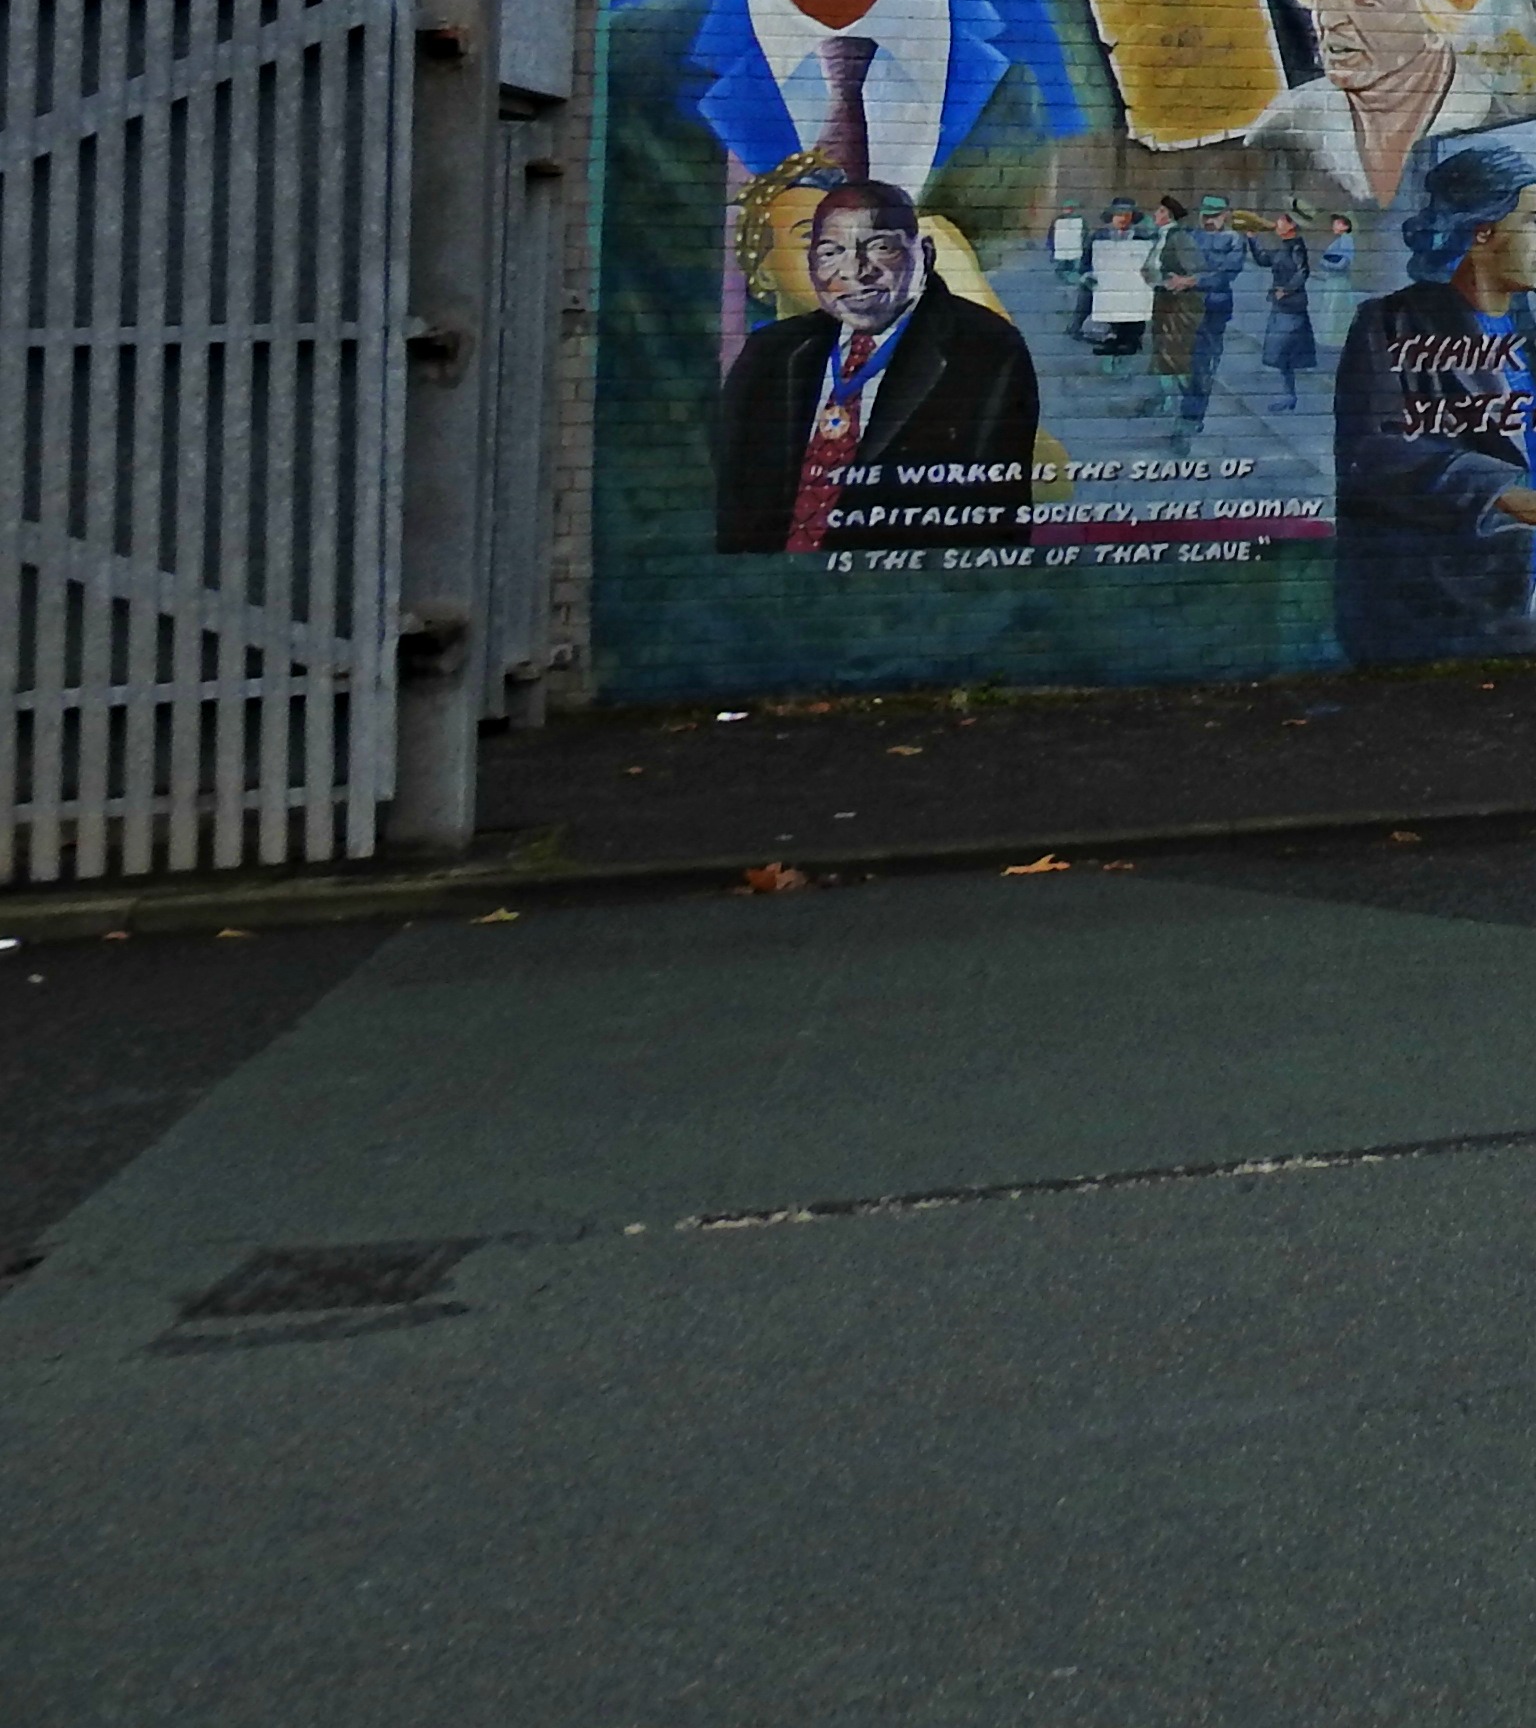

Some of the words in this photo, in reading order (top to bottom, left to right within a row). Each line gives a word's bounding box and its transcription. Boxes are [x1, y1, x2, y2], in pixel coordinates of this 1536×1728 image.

[1387, 333, 1528, 375] THANK
[897, 462, 1023, 484] WORKER
[1031, 462, 1058, 483] IS
[1064, 460, 1123, 481] THE
[1129, 459, 1210, 481] SLAVE
[1220, 458, 1255, 478] OF
[827, 505, 1006, 528] CAPITALIST
[1016, 502, 1138, 527] SOCIETY,
[1147, 500, 1204, 521] THE
[1213, 498, 1325, 520] WOMAN
[827, 550, 853, 572] IS
[865, 549, 927, 570] THE
[943, 547, 1035, 569] SLAVE
[1046, 546, 1081, 566] OF
[1095, 543, 1169, 564] THAT
